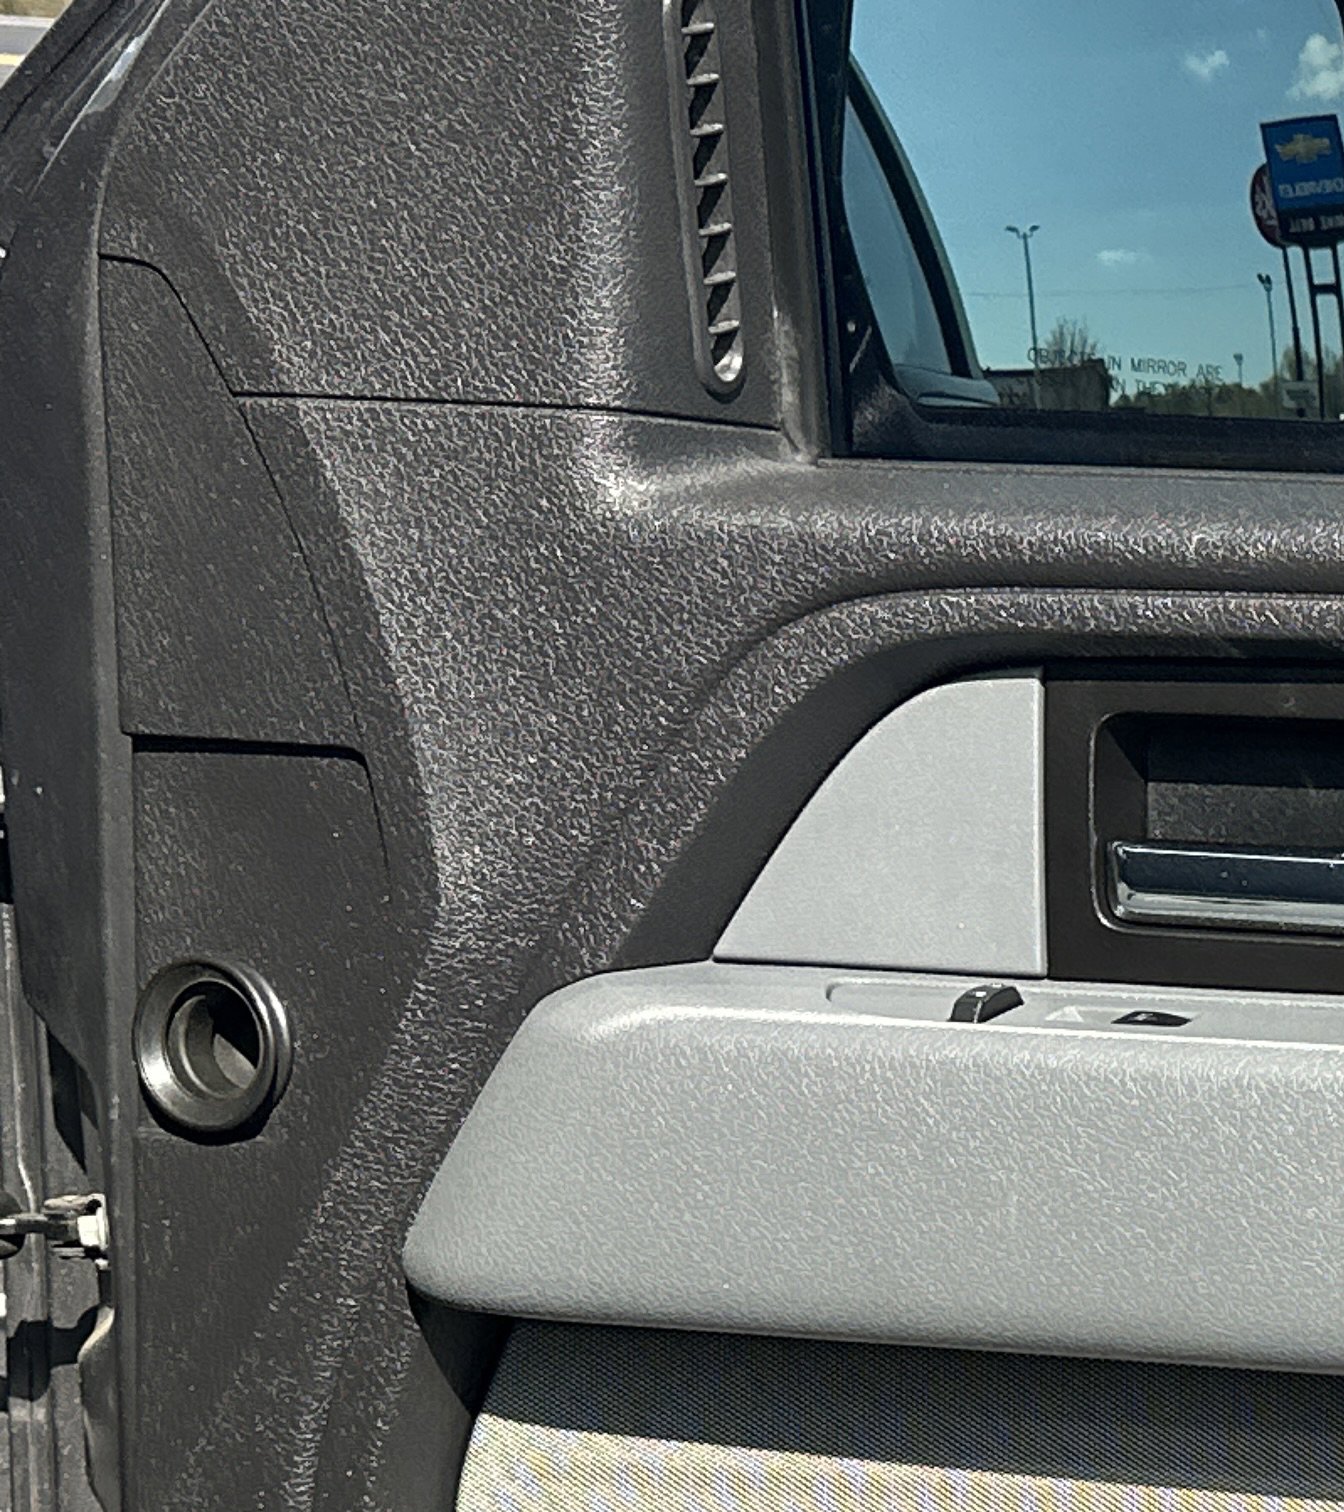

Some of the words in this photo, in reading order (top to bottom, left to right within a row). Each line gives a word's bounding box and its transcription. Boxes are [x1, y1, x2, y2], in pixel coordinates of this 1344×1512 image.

[1107, 354, 1122, 371] IN
[1130, 356, 1188, 377] MIRROR
[1196, 363, 1225, 382] ARE
